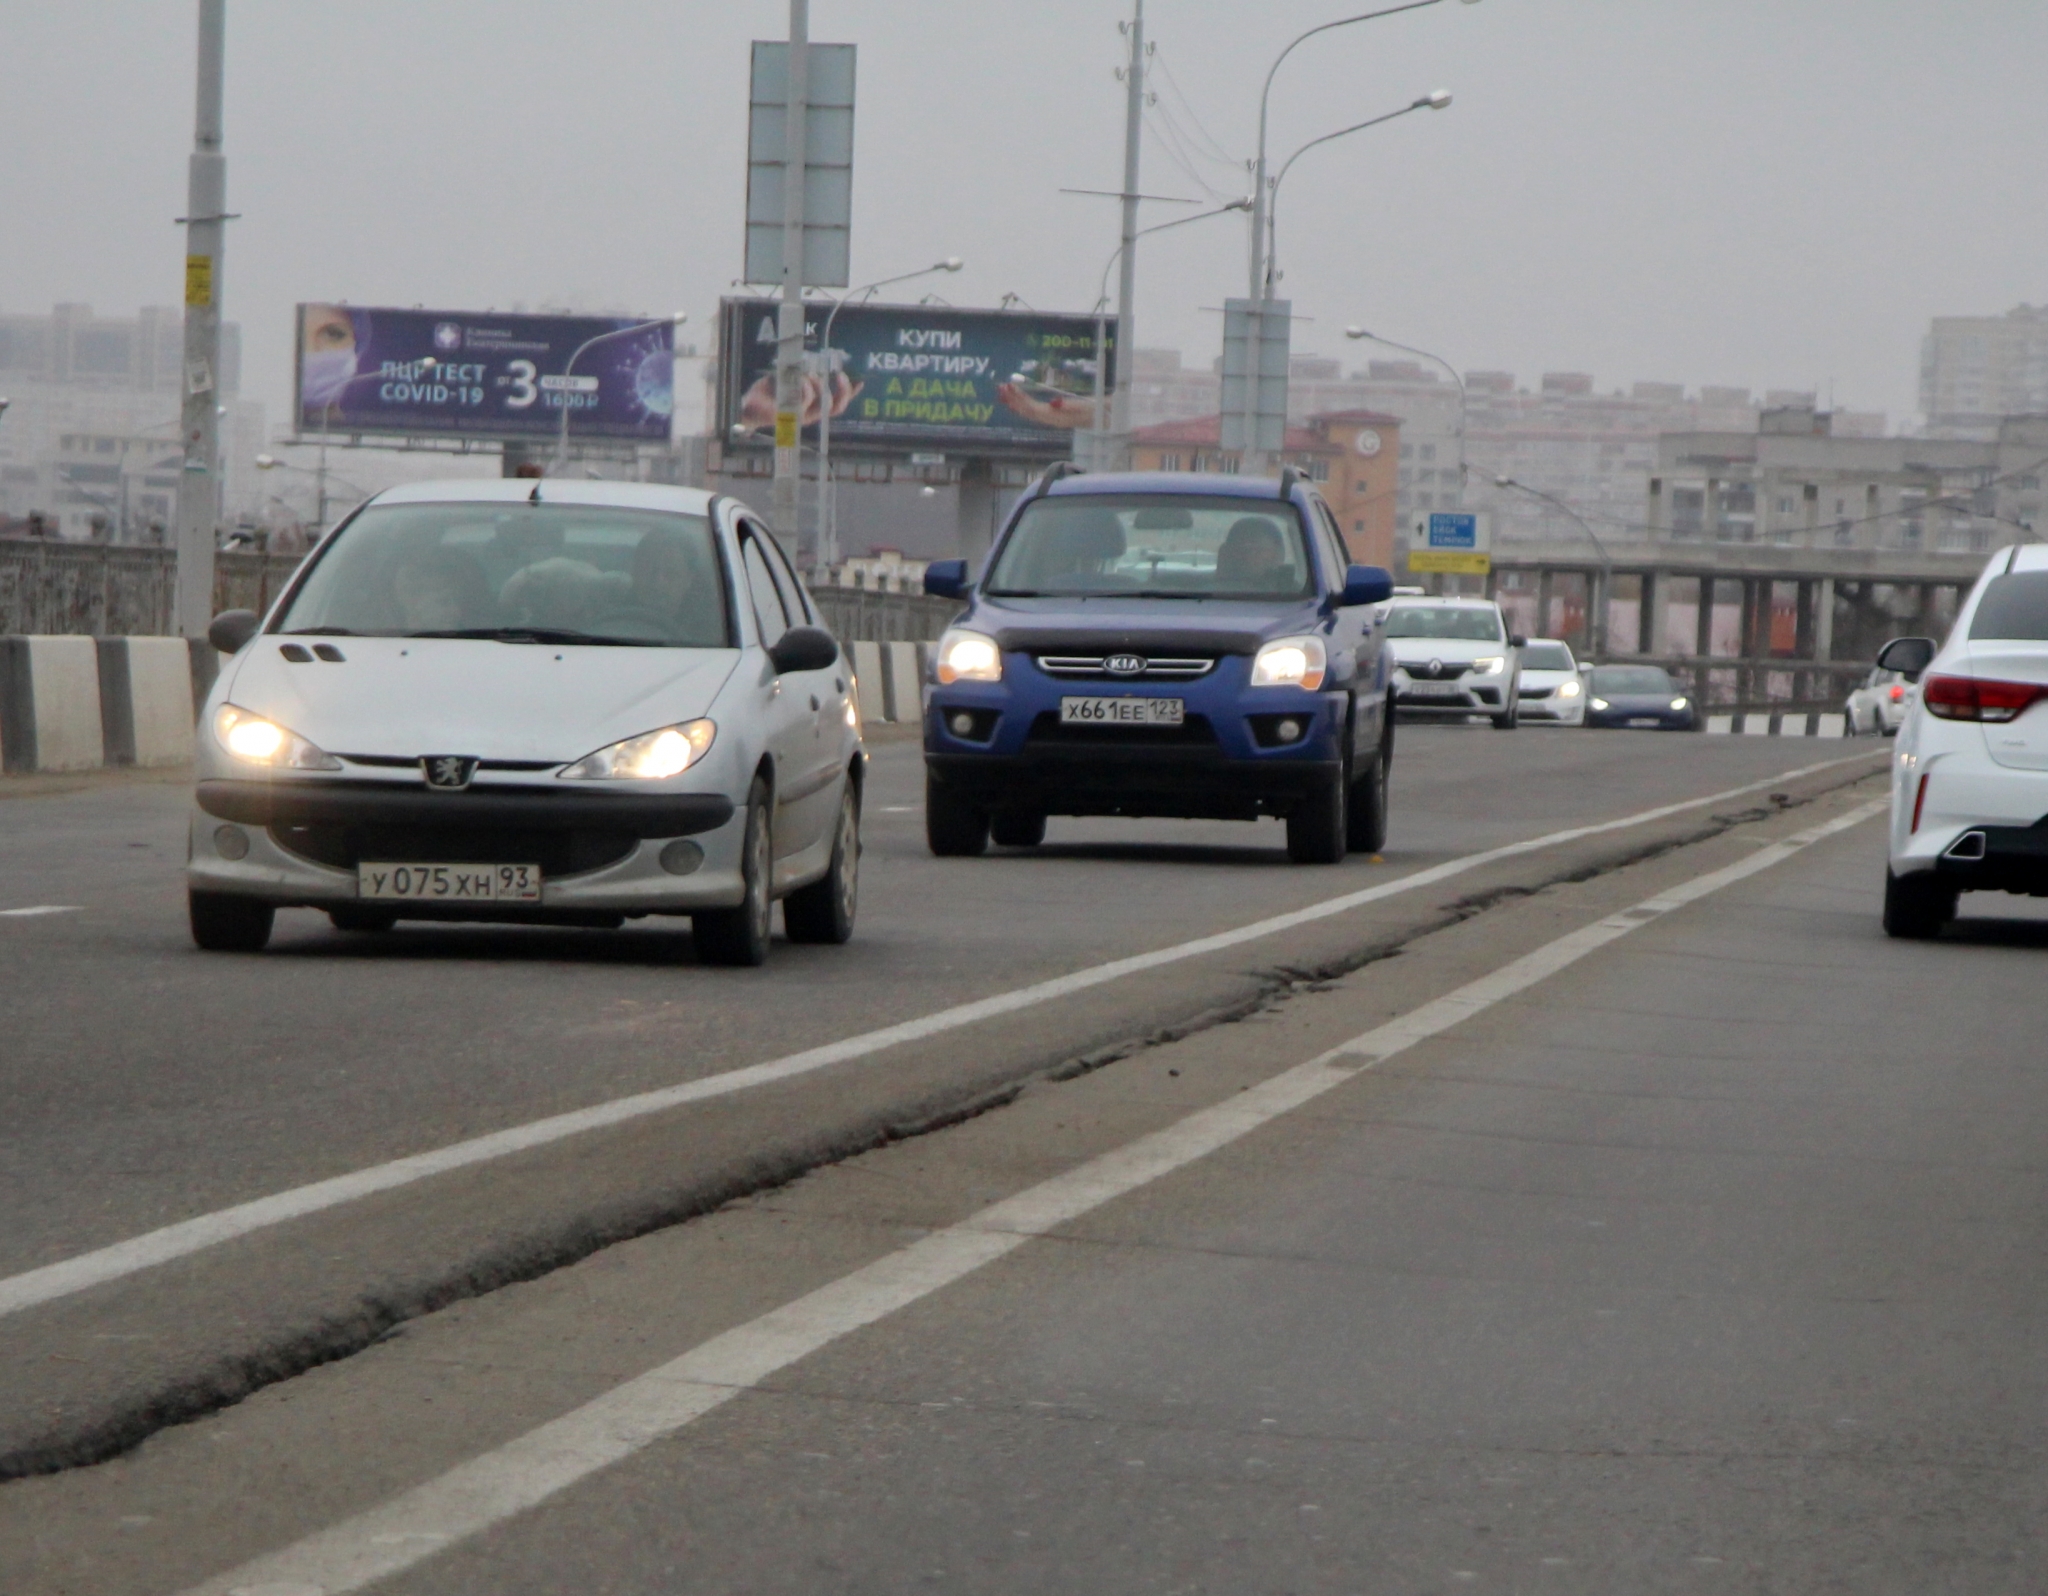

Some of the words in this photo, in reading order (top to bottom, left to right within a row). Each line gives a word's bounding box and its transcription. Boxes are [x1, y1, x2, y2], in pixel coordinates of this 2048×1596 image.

[899, 329, 961, 348] КУПИ
[381, 361, 424, 381] ПЦР
[434, 363, 486, 382] ТЕСТ
[868, 352, 995, 378] КВАРТИРУ,
[381, 383, 484, 404] COVID-19
[506, 359, 537, 407] 3
[886, 377, 903, 394] А
[908, 378, 977, 398] ДАЧА
[864, 399, 879, 417] В
[885, 400, 994, 423] ПРИДАЧУ
[1110, 658, 1141, 670] KIA
[1149, 701, 1179, 715] 123
[501, 867, 529, 889] 93
